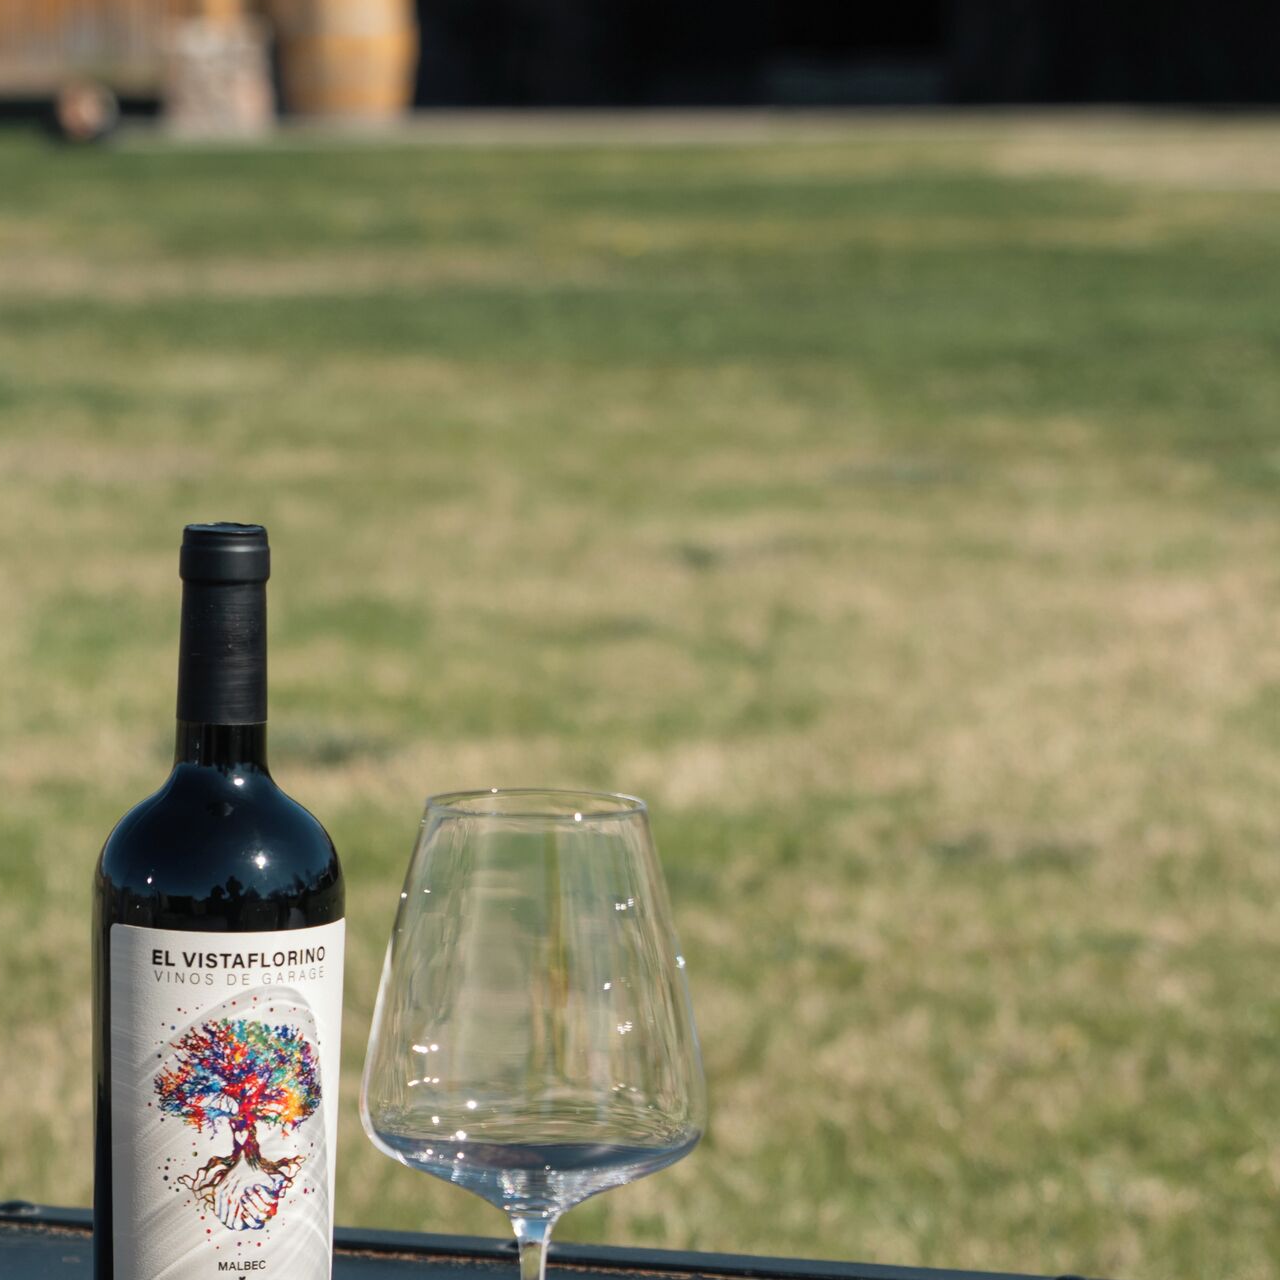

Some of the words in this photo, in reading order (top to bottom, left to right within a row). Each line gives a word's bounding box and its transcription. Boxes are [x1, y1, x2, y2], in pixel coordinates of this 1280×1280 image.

[152, 949, 175, 967] EL
[182, 946, 326, 969] VISTAFLORINO
[154, 970, 214, 986] VINOS
[226, 973, 250, 986] DE
[262, 966, 324, 986] GARAGE
[218, 1260, 266, 1271] MALBEC
